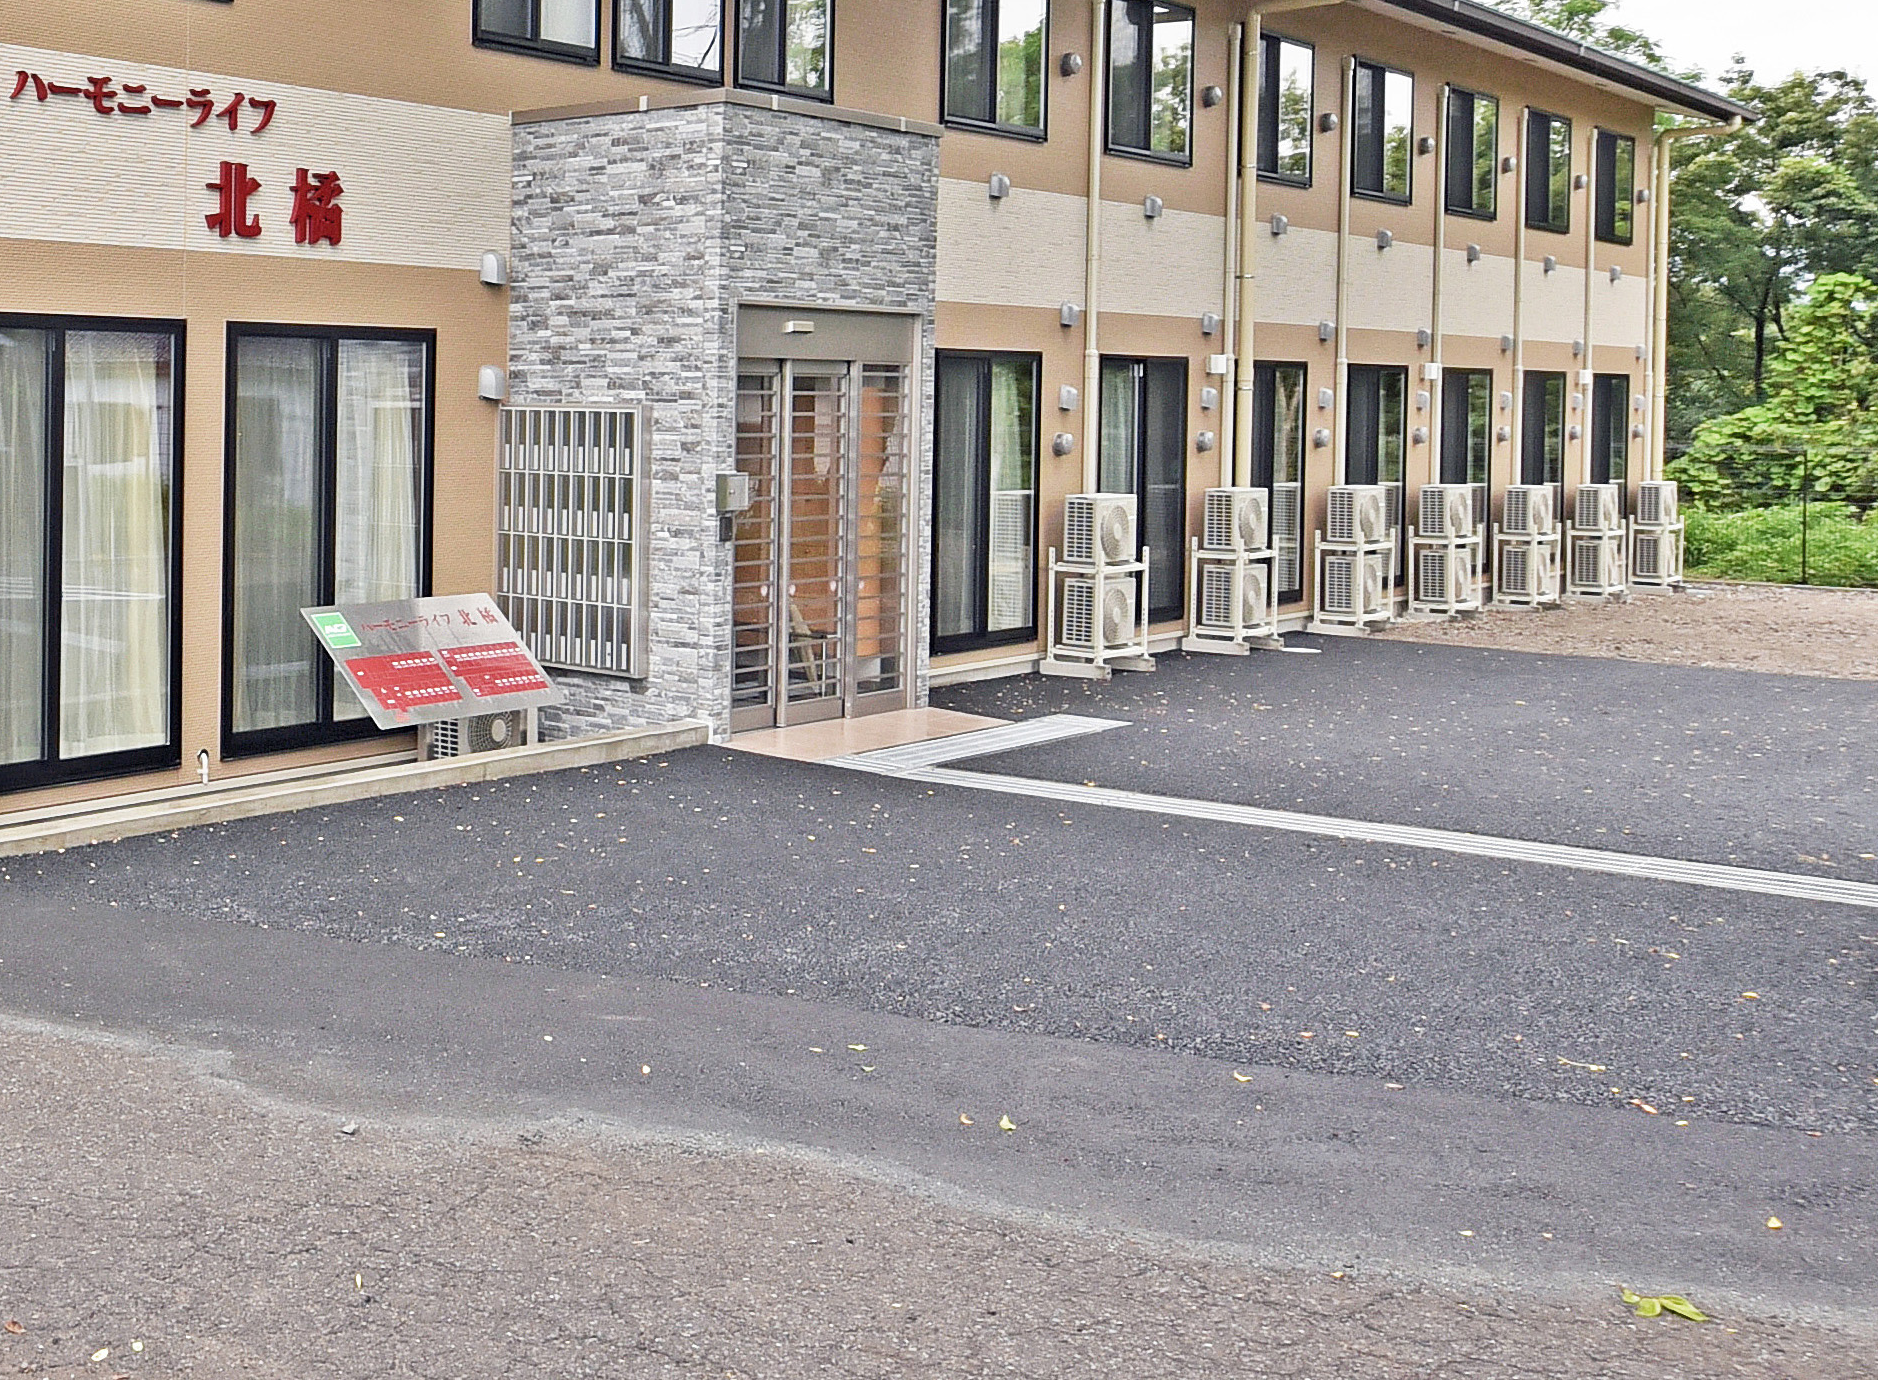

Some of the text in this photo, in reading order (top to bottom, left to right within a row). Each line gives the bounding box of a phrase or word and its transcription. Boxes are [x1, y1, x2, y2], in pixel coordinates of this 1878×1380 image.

[10, 71, 277, 134] ハーモニーライフ
[205, 161, 344, 246] 北橘
